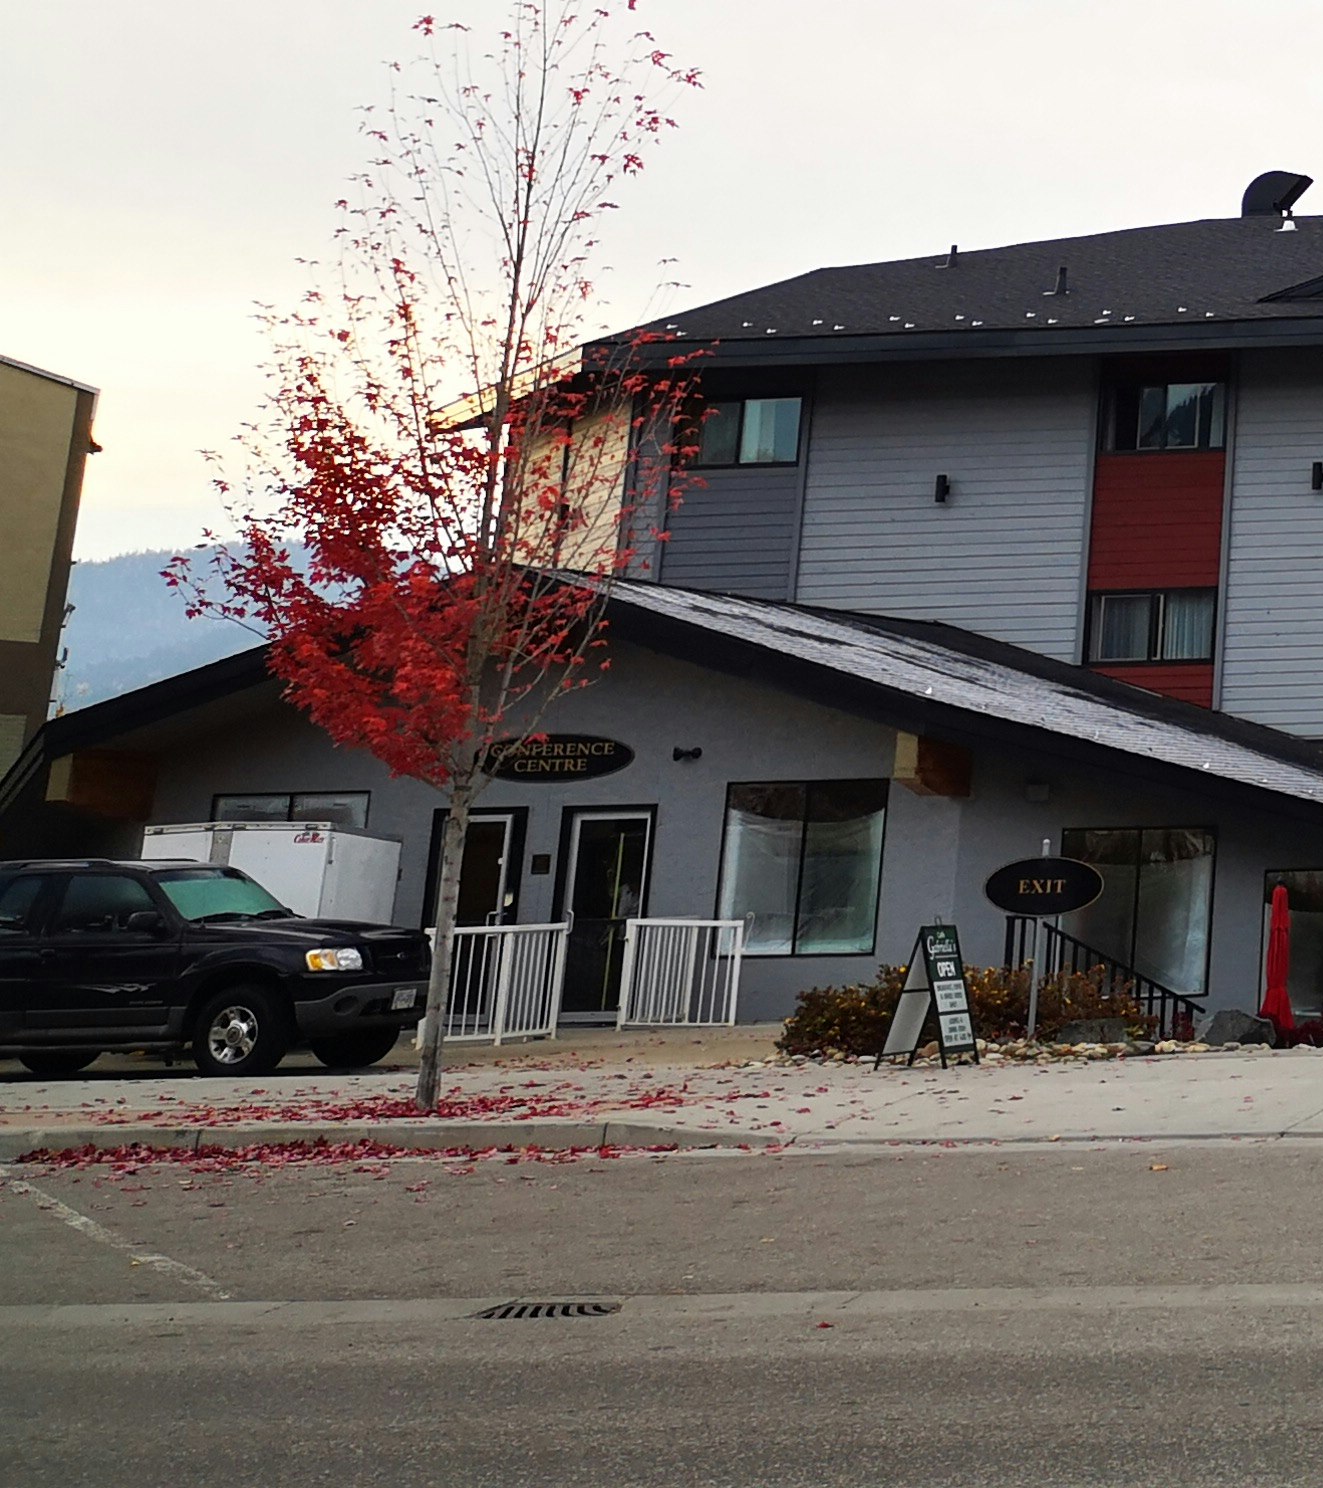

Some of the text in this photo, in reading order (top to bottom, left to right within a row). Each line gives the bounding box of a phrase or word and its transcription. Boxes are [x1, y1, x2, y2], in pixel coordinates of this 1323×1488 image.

[514, 758, 587, 773] CENTRE
[1019, 879, 1067, 894] EXIT
[936, 961, 957, 977] OPEN
